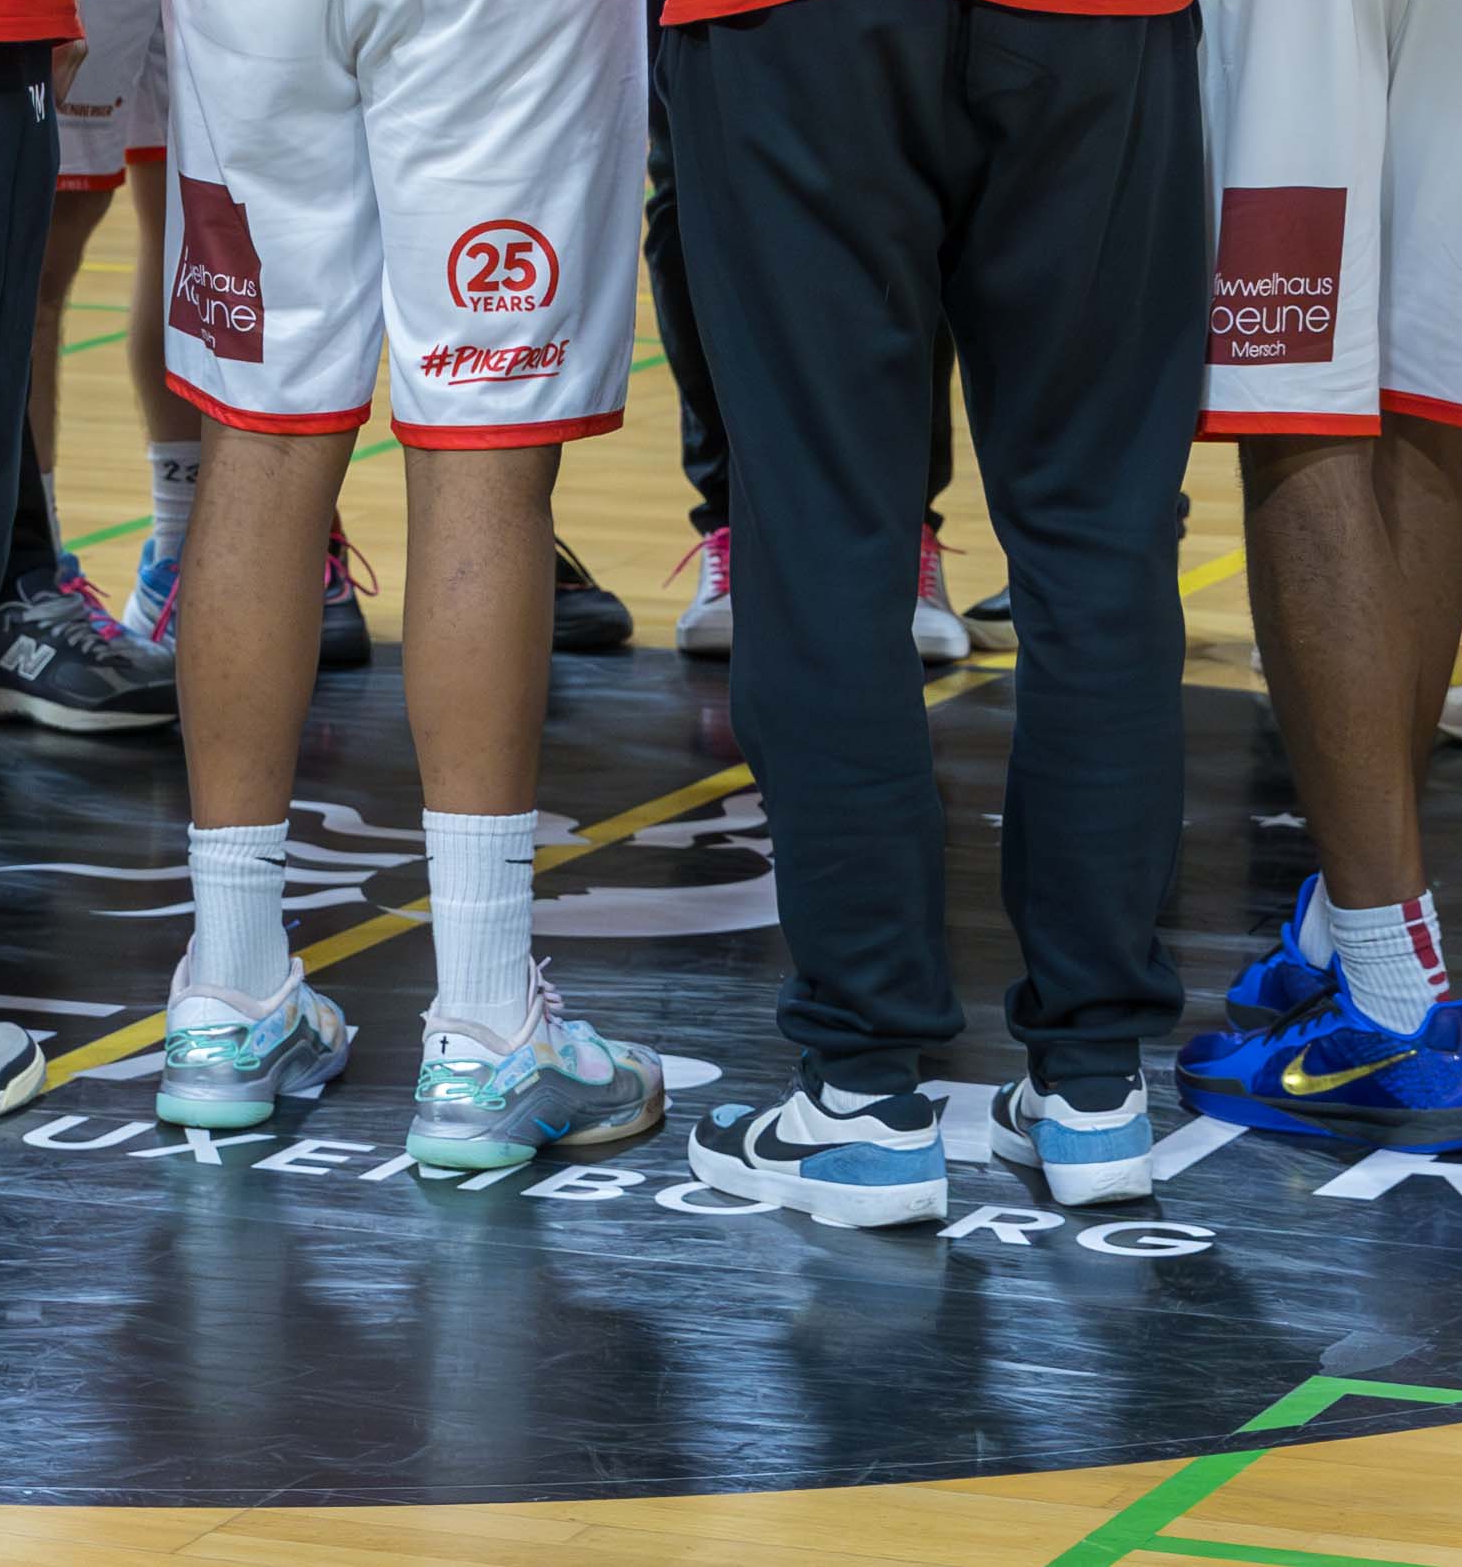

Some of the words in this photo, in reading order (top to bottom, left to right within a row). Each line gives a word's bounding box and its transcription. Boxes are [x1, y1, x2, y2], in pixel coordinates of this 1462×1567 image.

[466, 241, 537, 293] 25
[469, 295, 536, 313] YEARS
[1210, 305, 1331, 335] oeune
[420, 339, 570, 378] #PIKEPRIDE
[1232, 340, 1286, 358] Mersch
